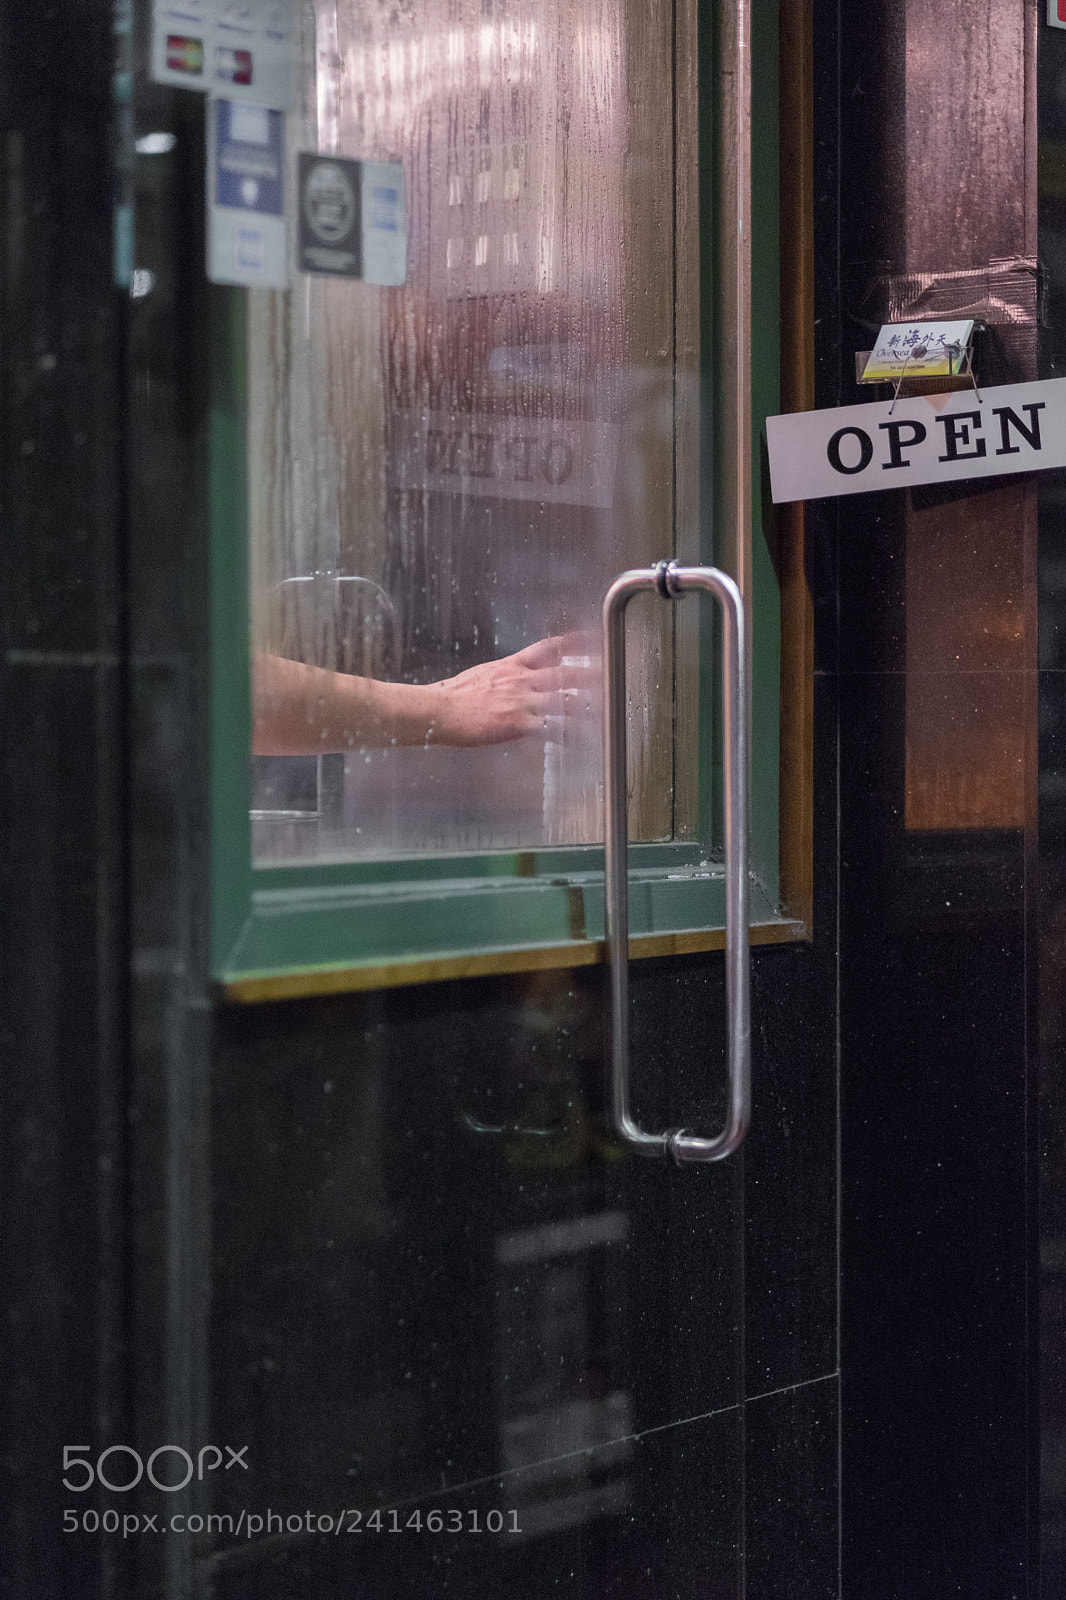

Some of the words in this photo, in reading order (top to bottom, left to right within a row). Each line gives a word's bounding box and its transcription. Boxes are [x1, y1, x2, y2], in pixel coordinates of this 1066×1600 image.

[887, 329, 947, 348] 新海外天
[827, 402, 1046, 475] OPEN
